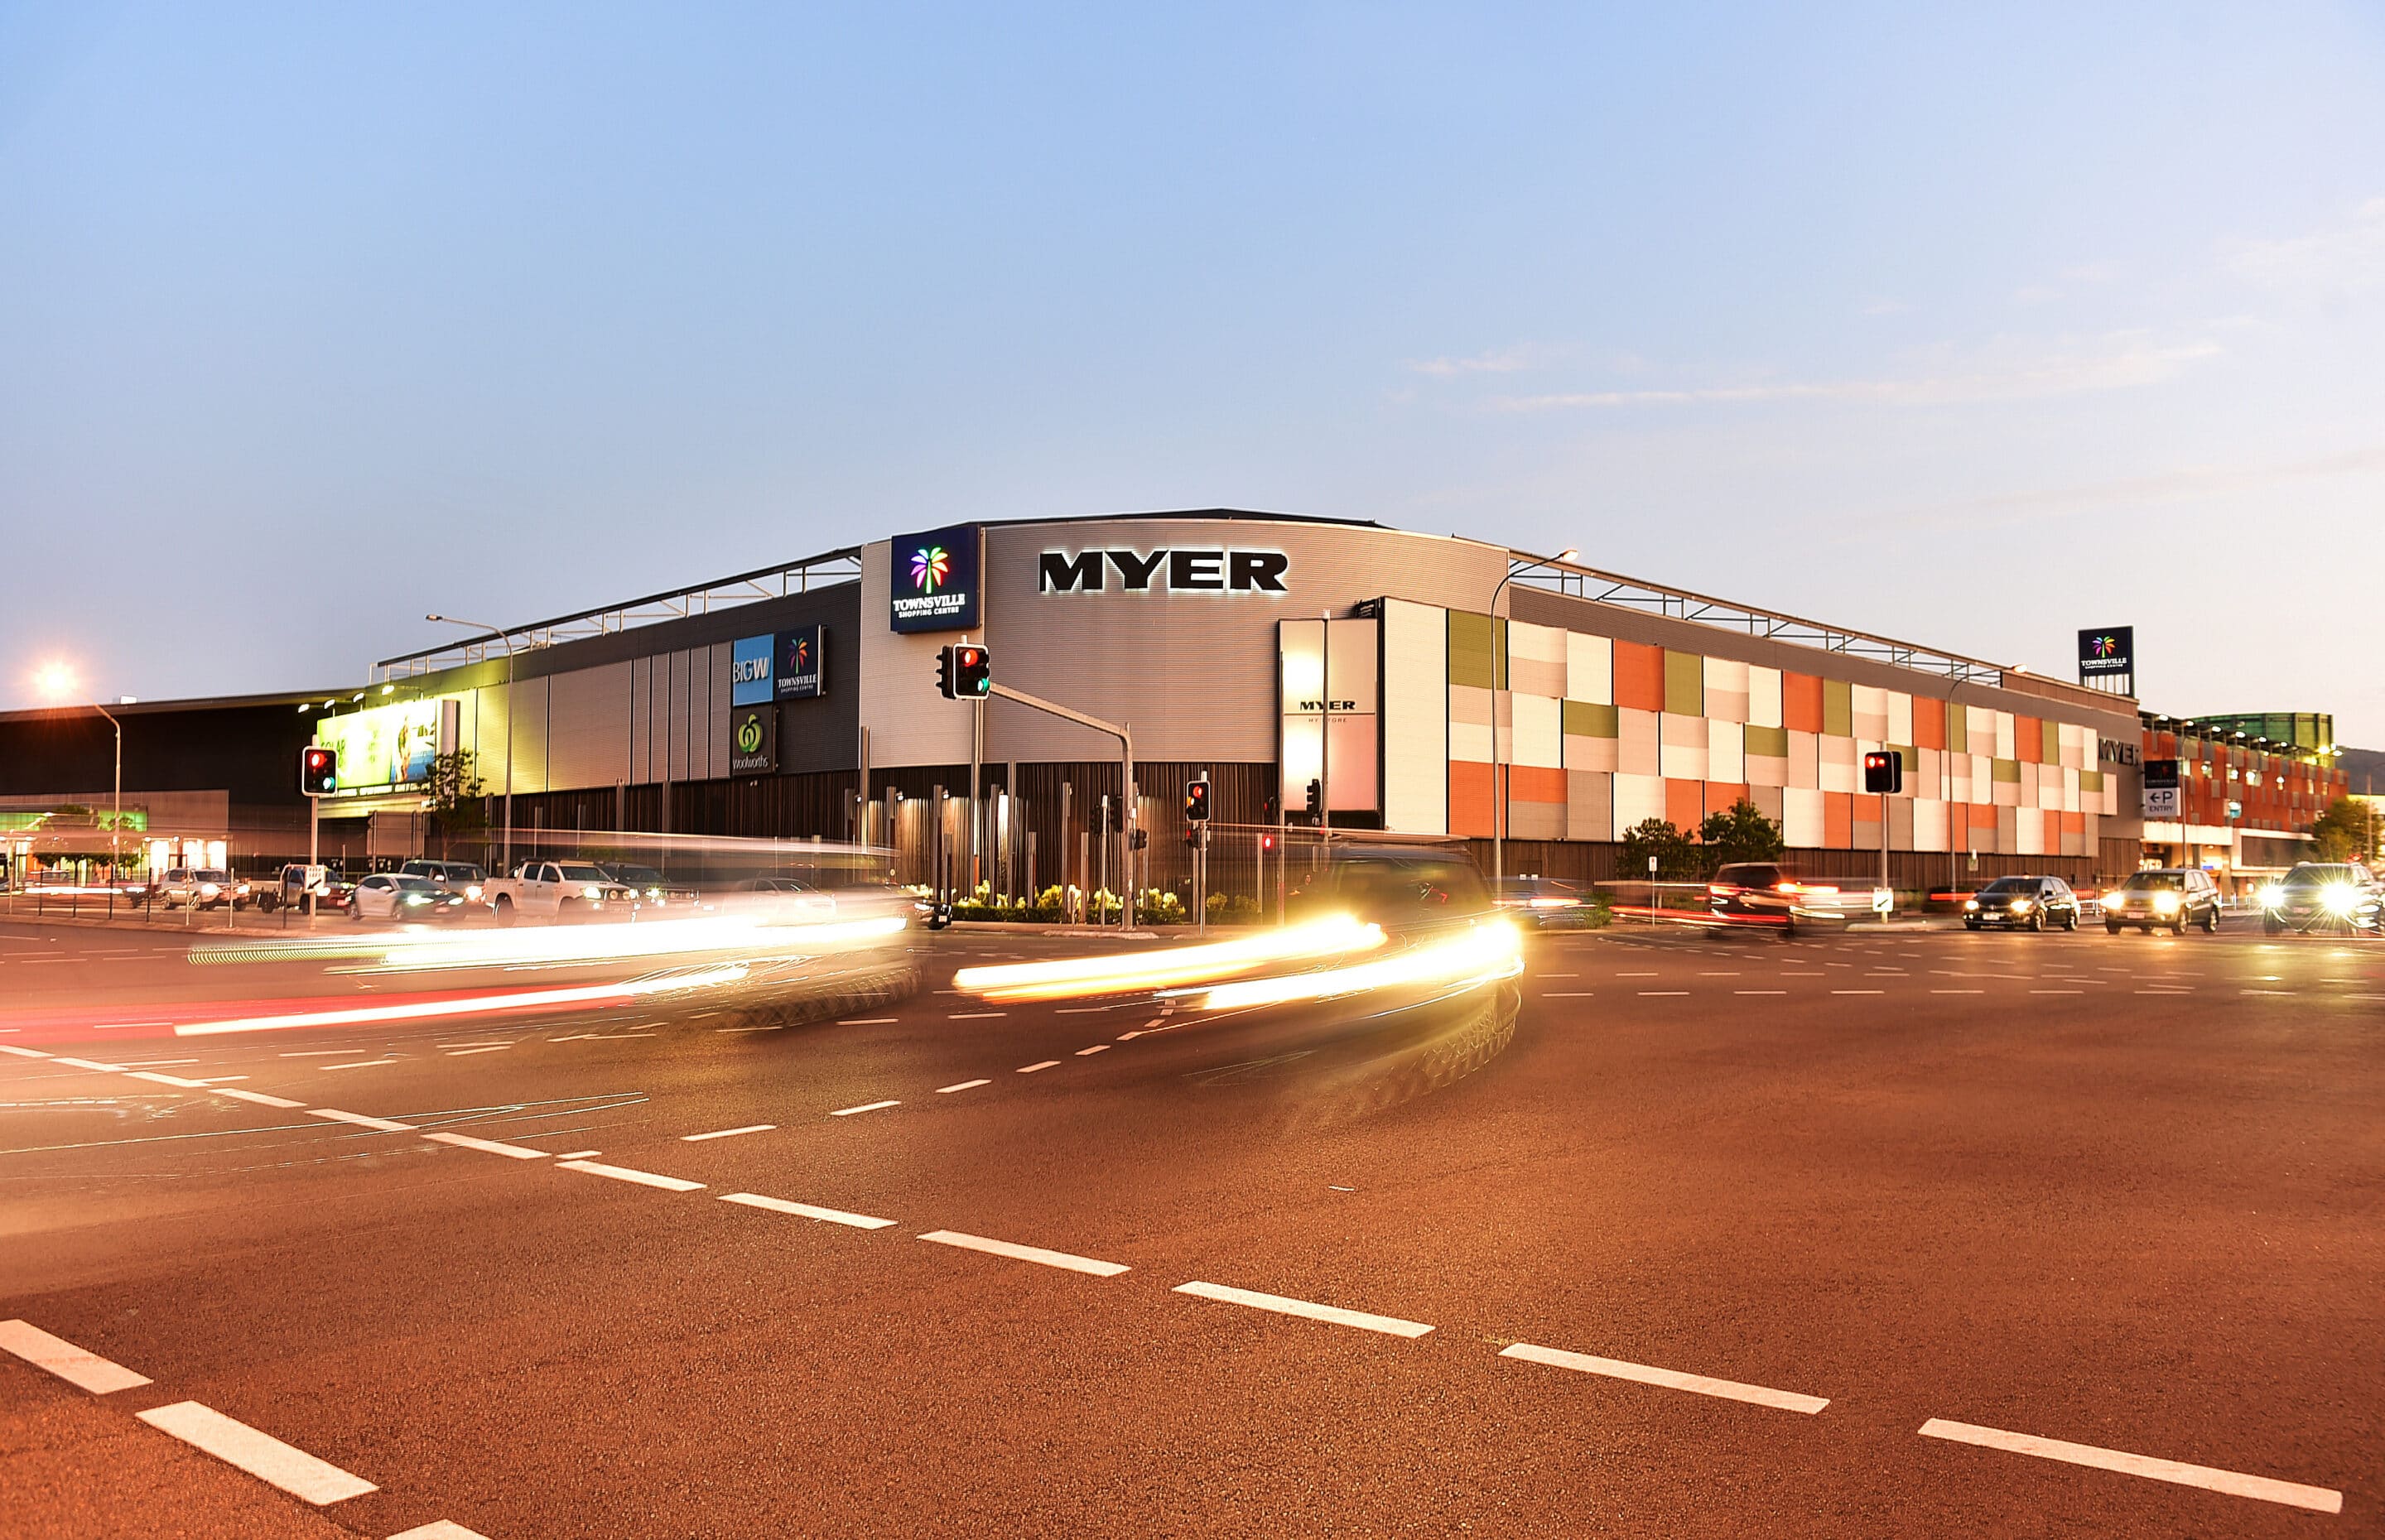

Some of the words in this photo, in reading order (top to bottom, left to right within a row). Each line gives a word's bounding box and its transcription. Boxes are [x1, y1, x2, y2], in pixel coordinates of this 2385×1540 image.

[1039, 550, 1289, 592] MYER
[893, 594, 966, 611] TOWNSVILLE
[899, 609, 932, 618] SHOPPING
[933, 606, 960, 615] CENTRE
[2081, 657, 2127, 667] TOWNSVILLE
[778, 674, 817, 690] TOWNSVILLE
[1300, 700, 1356, 710] MYER
[2098, 737, 2142, 767] MYER
[733, 754, 768, 770] woolworths
[2163, 792, 2173, 804] P
